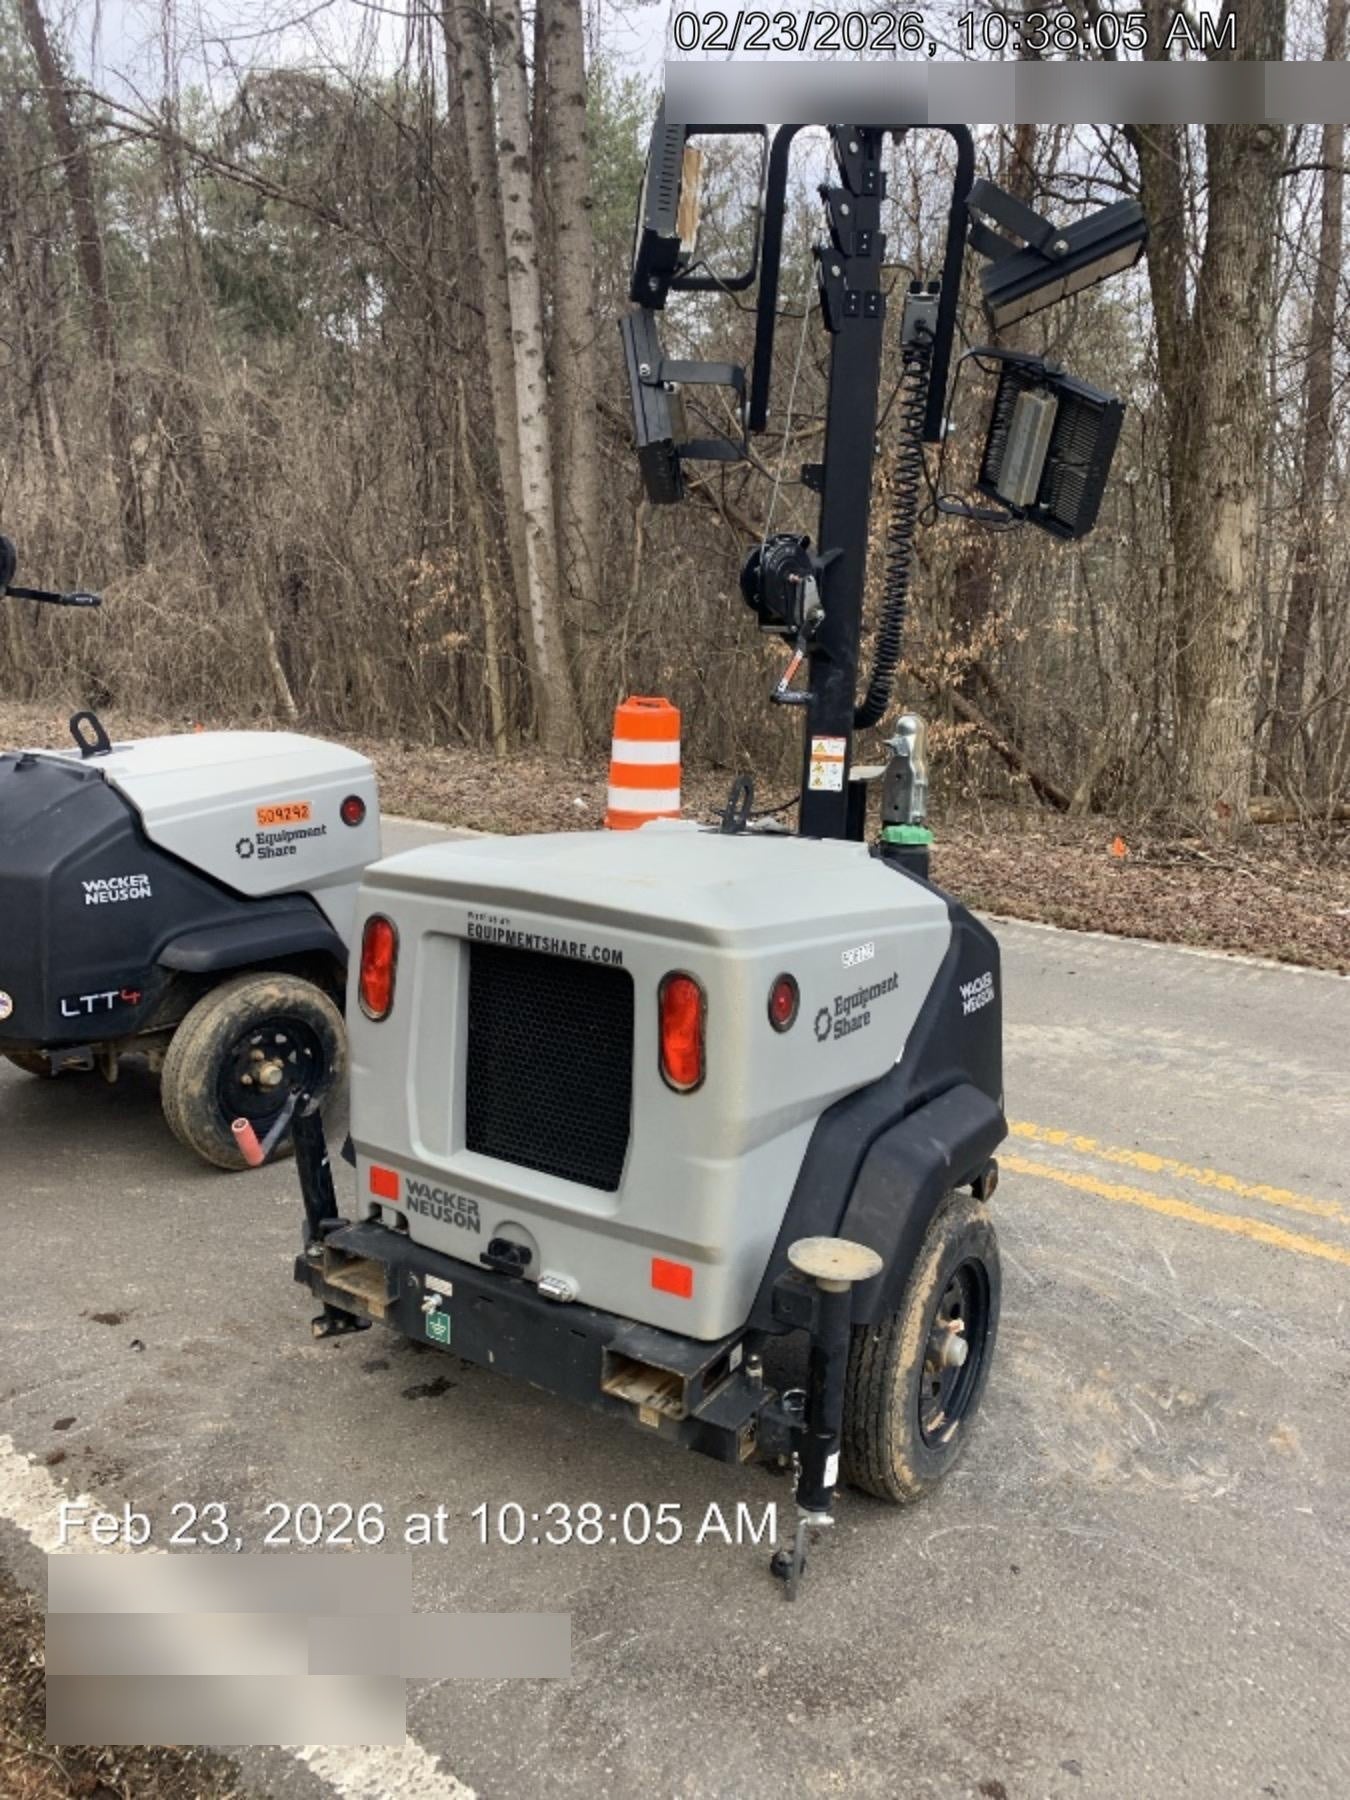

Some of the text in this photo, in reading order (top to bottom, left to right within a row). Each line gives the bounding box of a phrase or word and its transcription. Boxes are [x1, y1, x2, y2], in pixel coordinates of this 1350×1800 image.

[256, 824, 327, 846] Equipment
[257, 844, 297, 860] Share
[81, 874, 149, 893] WACKER
[85, 885, 152, 905] NEUSON
[467, 922, 623, 965] EQUIPMENTSHARE.COM
[61, 988, 140, 1017] LTT4
[833, 972, 899, 1016] Equipment
[833, 1010, 871, 1040] Share
[405, 1178, 480, 1215] WACKER
[406, 1196, 481, 1234] NEUSON
